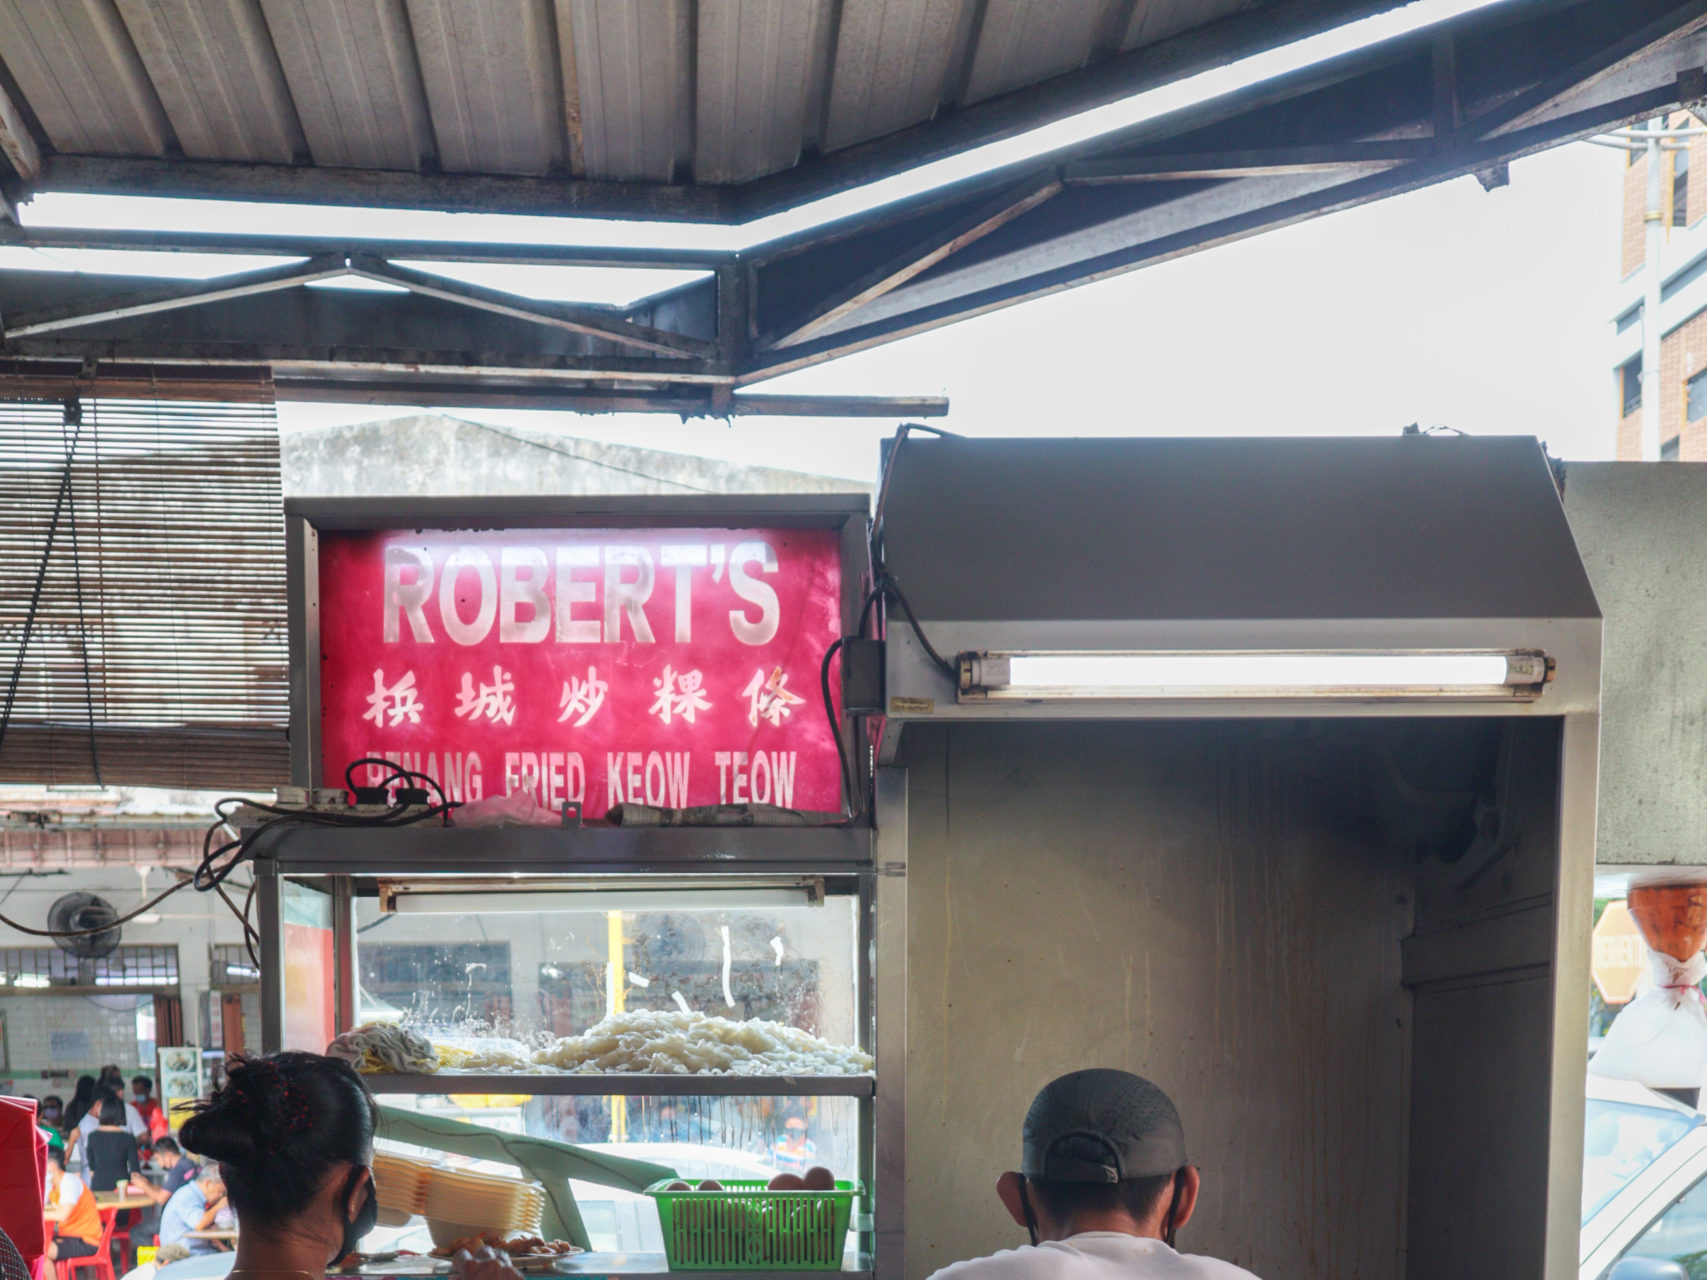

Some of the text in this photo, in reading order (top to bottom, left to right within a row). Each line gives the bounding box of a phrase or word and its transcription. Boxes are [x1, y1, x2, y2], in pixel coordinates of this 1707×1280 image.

[382, 541, 781, 646] ROBERT'S
[505, 751, 586, 810] FRIED
[607, 751, 690, 809] KEOW
[715, 751, 797, 809] TEOW
